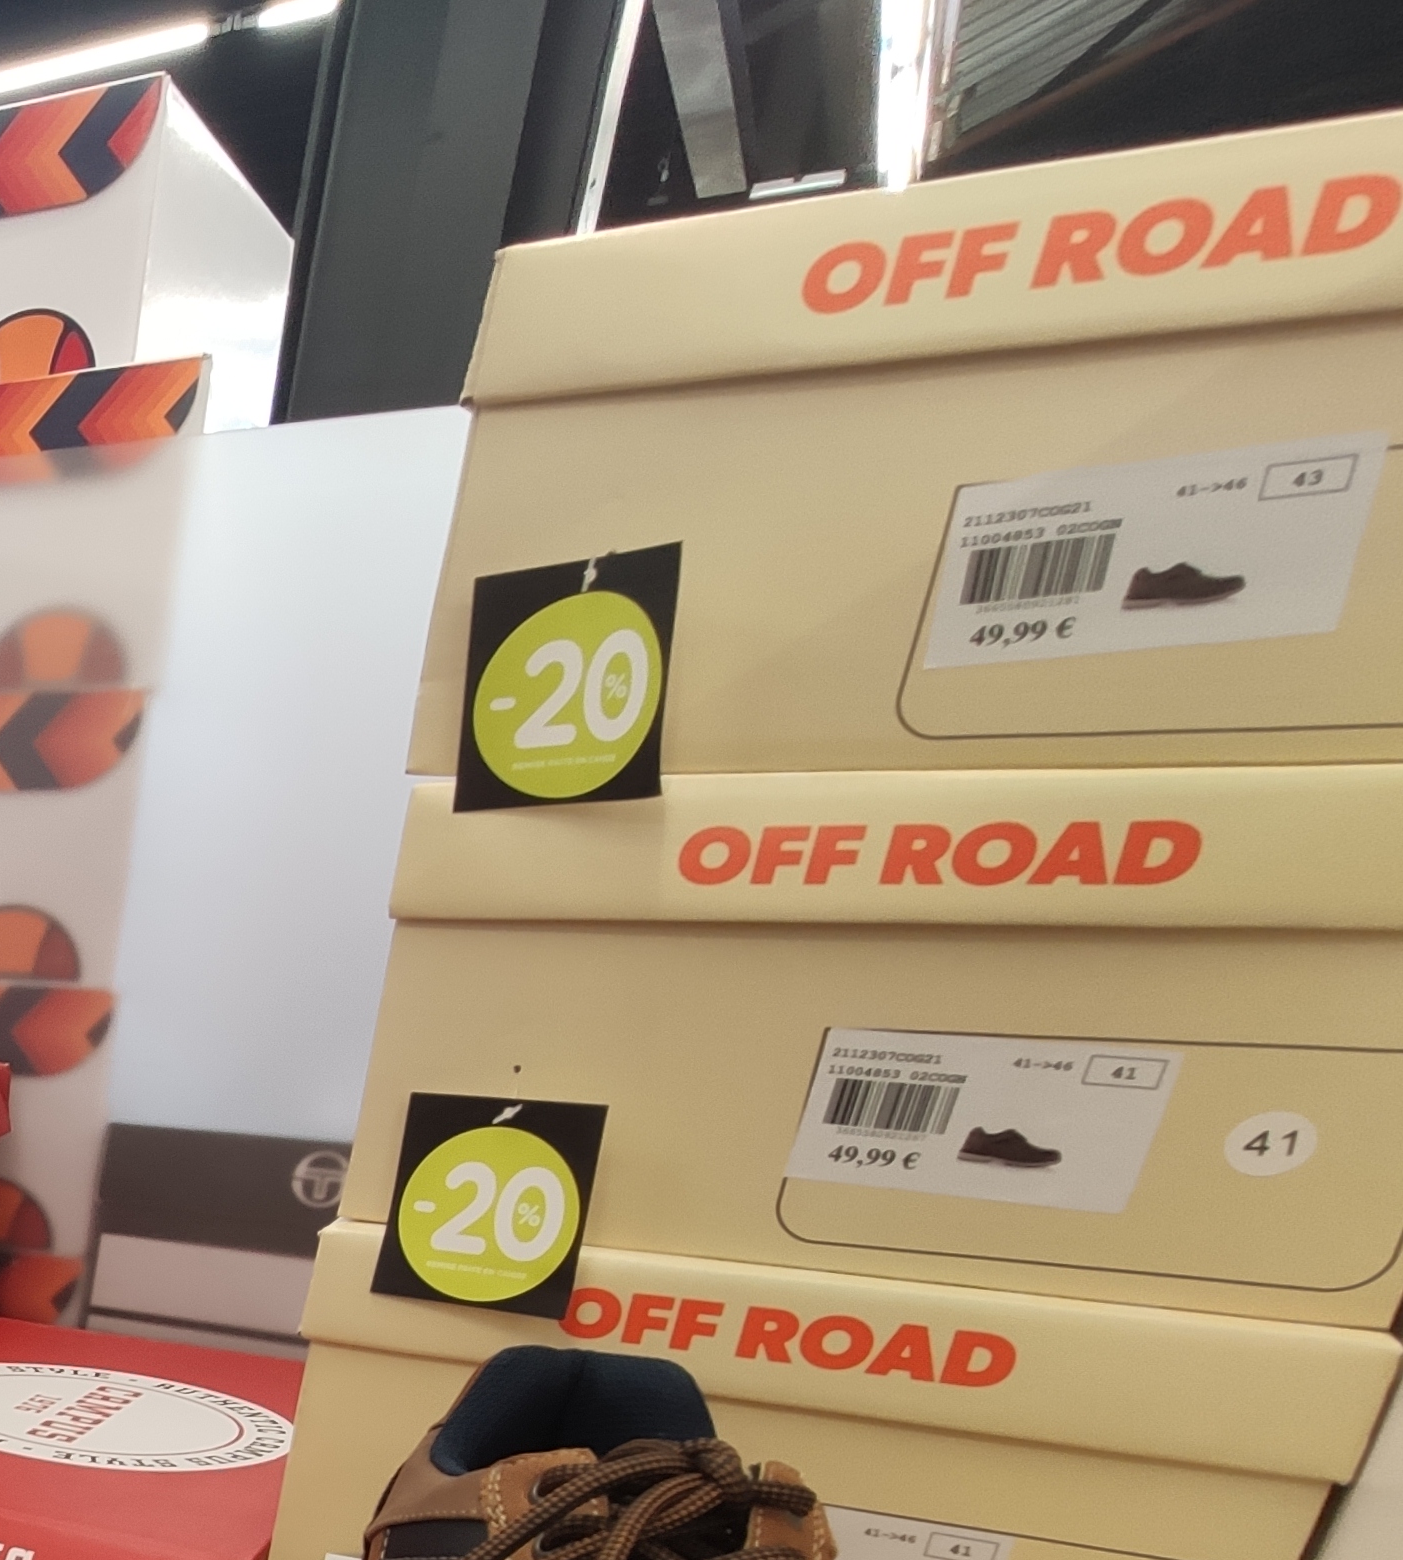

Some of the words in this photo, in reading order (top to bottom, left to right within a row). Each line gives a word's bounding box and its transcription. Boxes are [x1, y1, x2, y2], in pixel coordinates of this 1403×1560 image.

[801, 221, 1024, 316] OFF
[1029, 173, 1403, 291] ROAD
[1292, 469, 1323, 488] 43
[969, 618, 1048, 649] 49,99
[1055, 616, 1078, 639] €
[677, 825, 868, 886] OFF
[878, 821, 1202, 887] ROAD
[1110, 1064, 1138, 1082] 41
[827, 1144, 897, 1170] 49,99
[901, 1149, 922, 1171] €
[1242, 1129, 1300, 1158] 41
[556, 1286, 726, 1354] OFF
[735, 1306, 1018, 1390] ROAD
[26, 1384, 146, 1444] CAMPUS
[949, 1542, 973, 1559] 41
